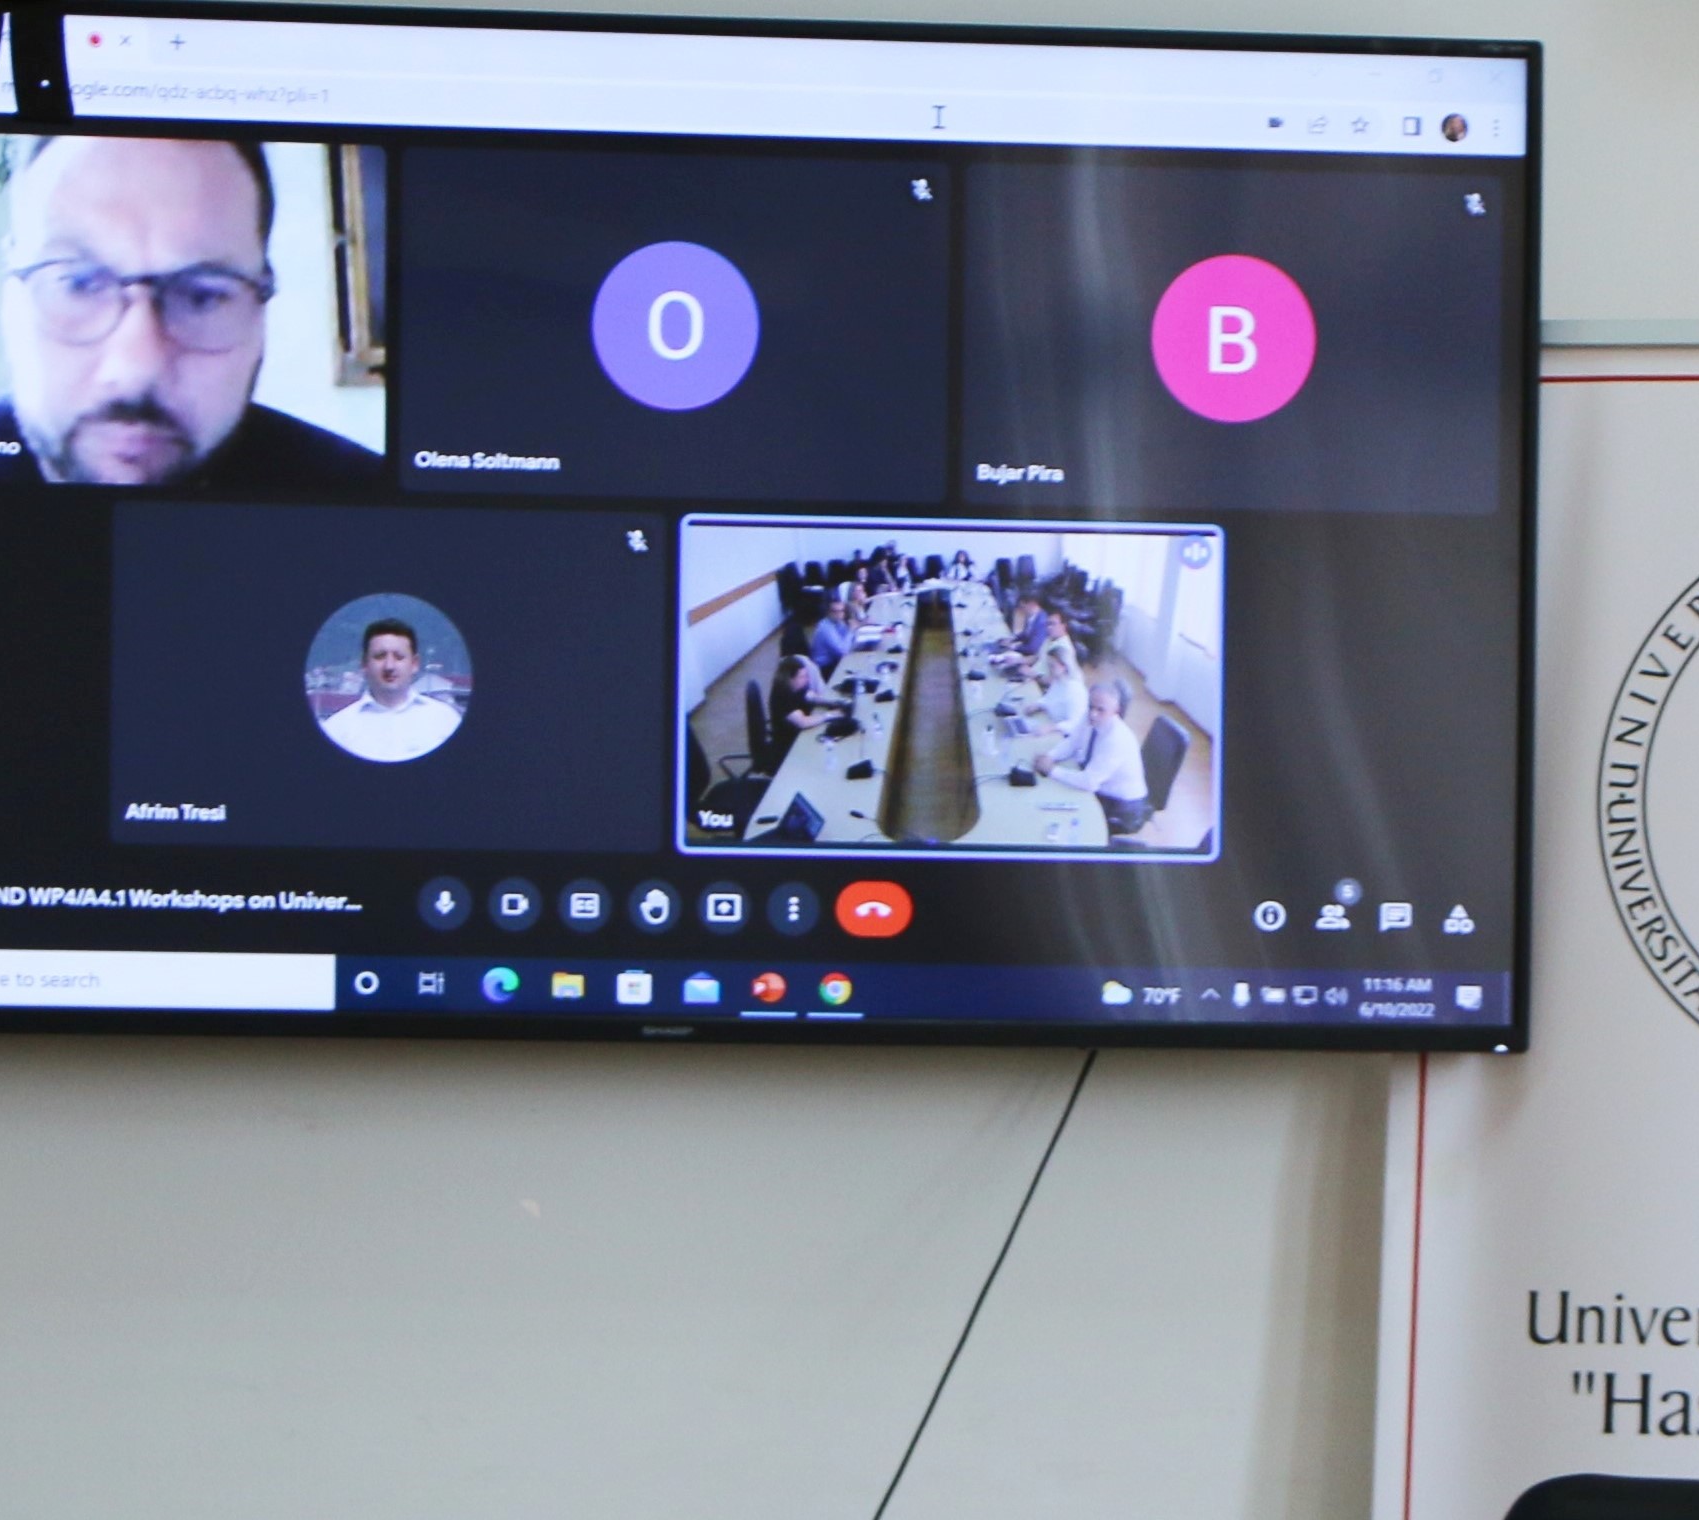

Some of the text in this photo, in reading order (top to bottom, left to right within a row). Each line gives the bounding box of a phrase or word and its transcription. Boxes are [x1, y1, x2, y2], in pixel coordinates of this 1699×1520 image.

[647, 290, 705, 360] O
[1207, 306, 1259, 374] B
[415, 450, 561, 473] Olena Soltmann
[976, 462, 1065, 485] Bujar Pira
[125, 802, 227, 823] Afrim Tresi
[699, 809, 734, 830] You
[29, 887, 126, 907] WP4/A4.1
[128, 889, 246, 913] Workshops
[248, 894, 276, 910] on
[15, 972, 34, 987] to
[40, 971, 100, 990] search
[1404, 977, 1433, 993] AM
